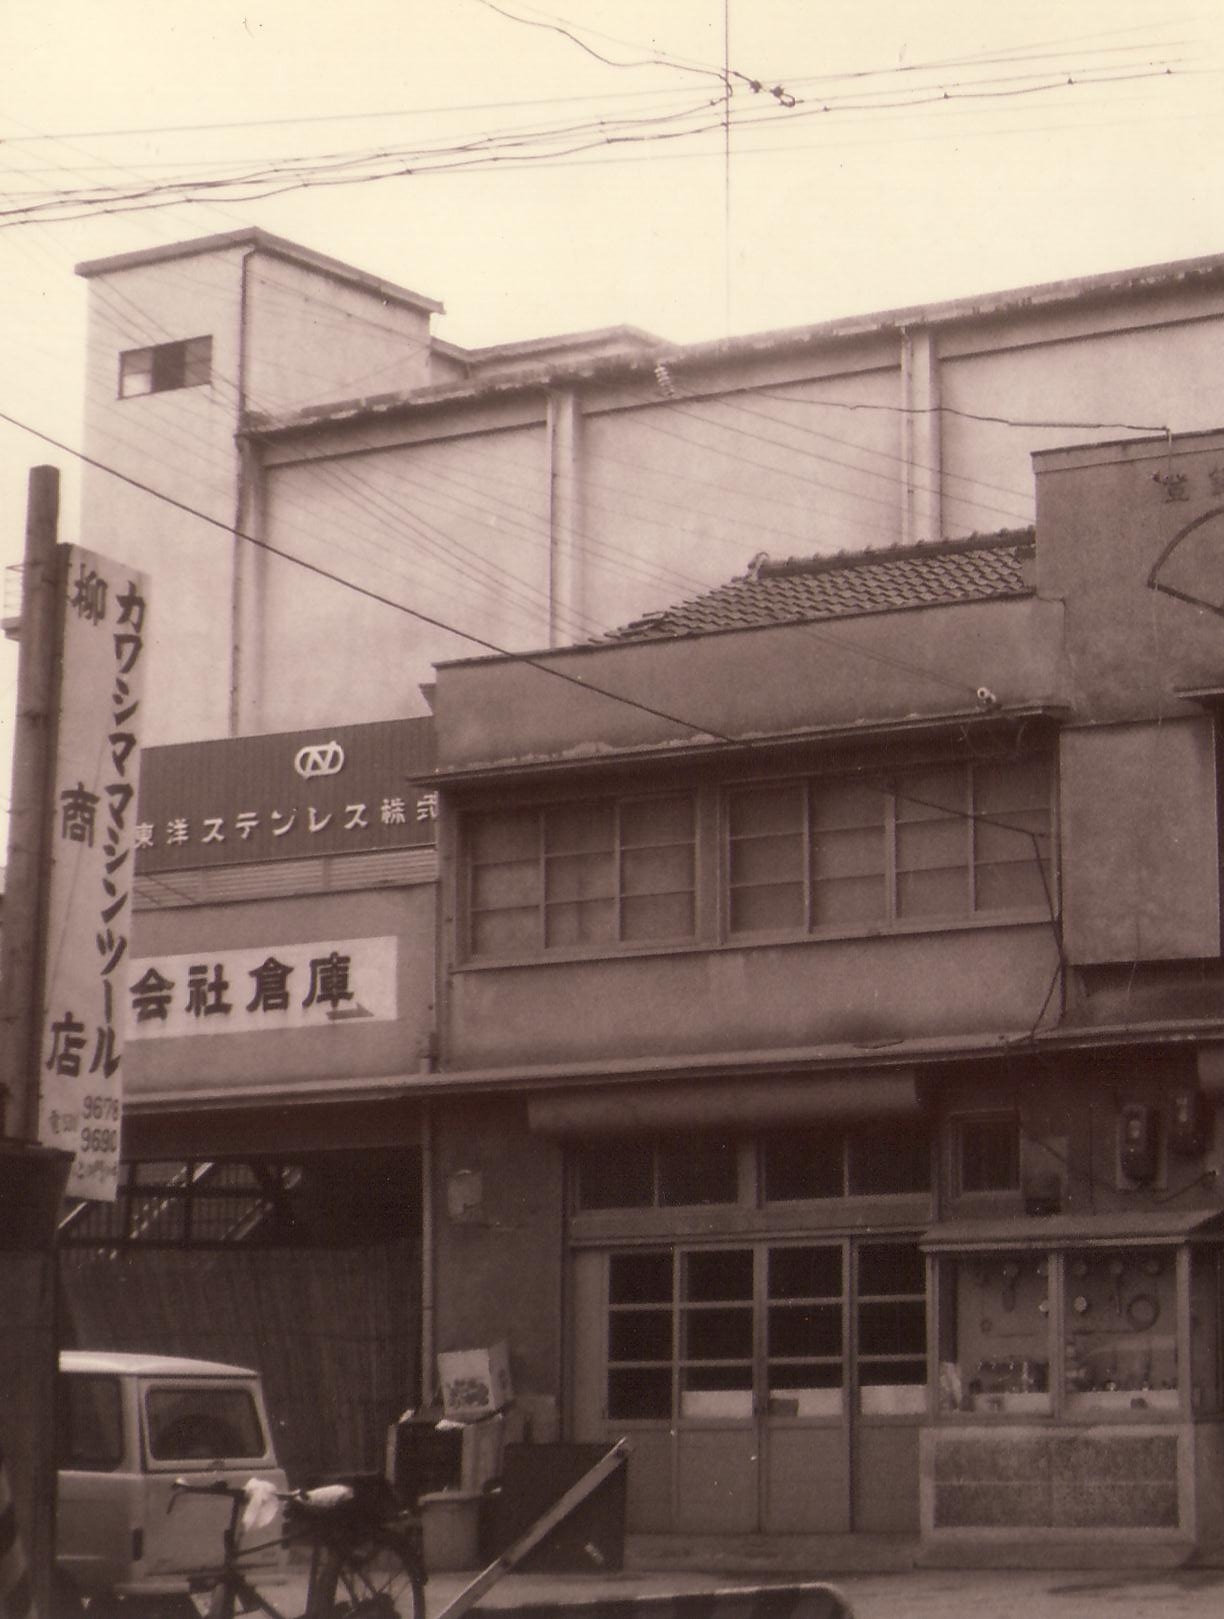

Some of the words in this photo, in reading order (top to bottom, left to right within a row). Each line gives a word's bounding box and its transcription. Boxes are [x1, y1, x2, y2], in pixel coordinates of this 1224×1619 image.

[89, 580, 145, 1079] カワシママシンツール
[129, 951, 354, 1023] 会社倉庫
